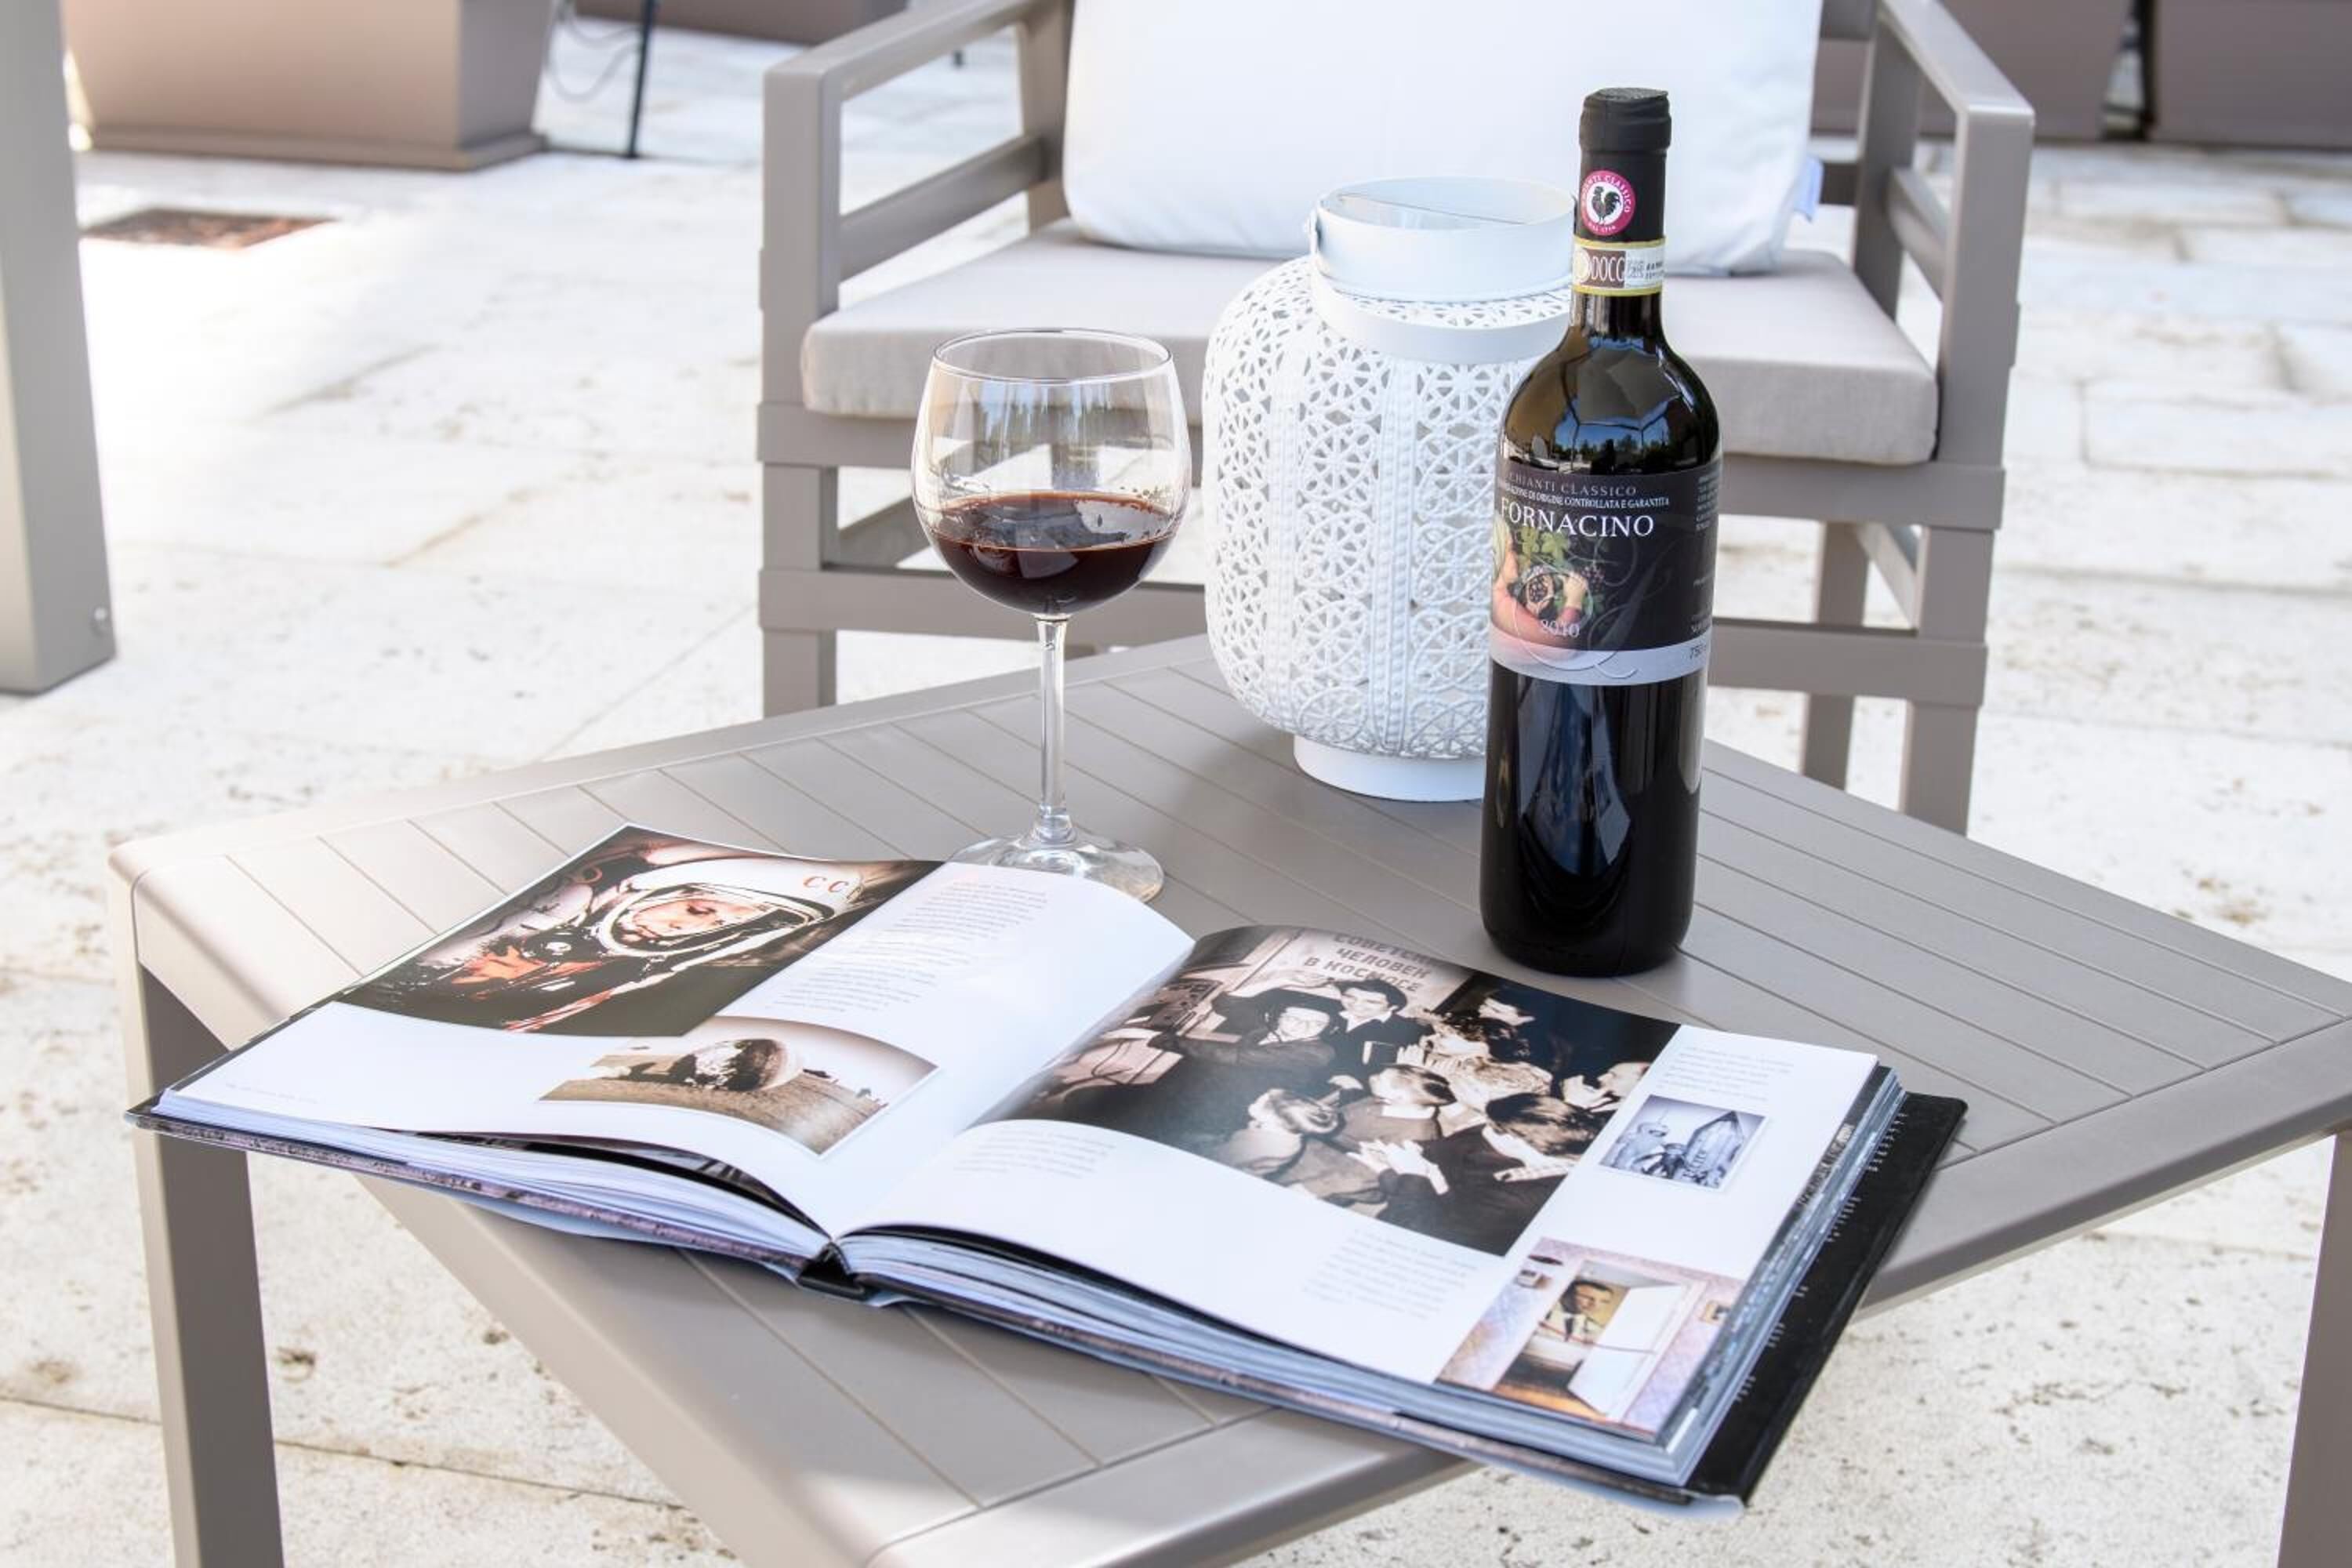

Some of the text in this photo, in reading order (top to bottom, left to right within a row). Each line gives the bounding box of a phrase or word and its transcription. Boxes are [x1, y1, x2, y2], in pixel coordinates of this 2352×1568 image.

[1561, 481, 1637, 497] CLASSICO
[1501, 495, 1654, 538] FORNACINO
[1336, 947, 1432, 979] ЧЕЛОВЕК
